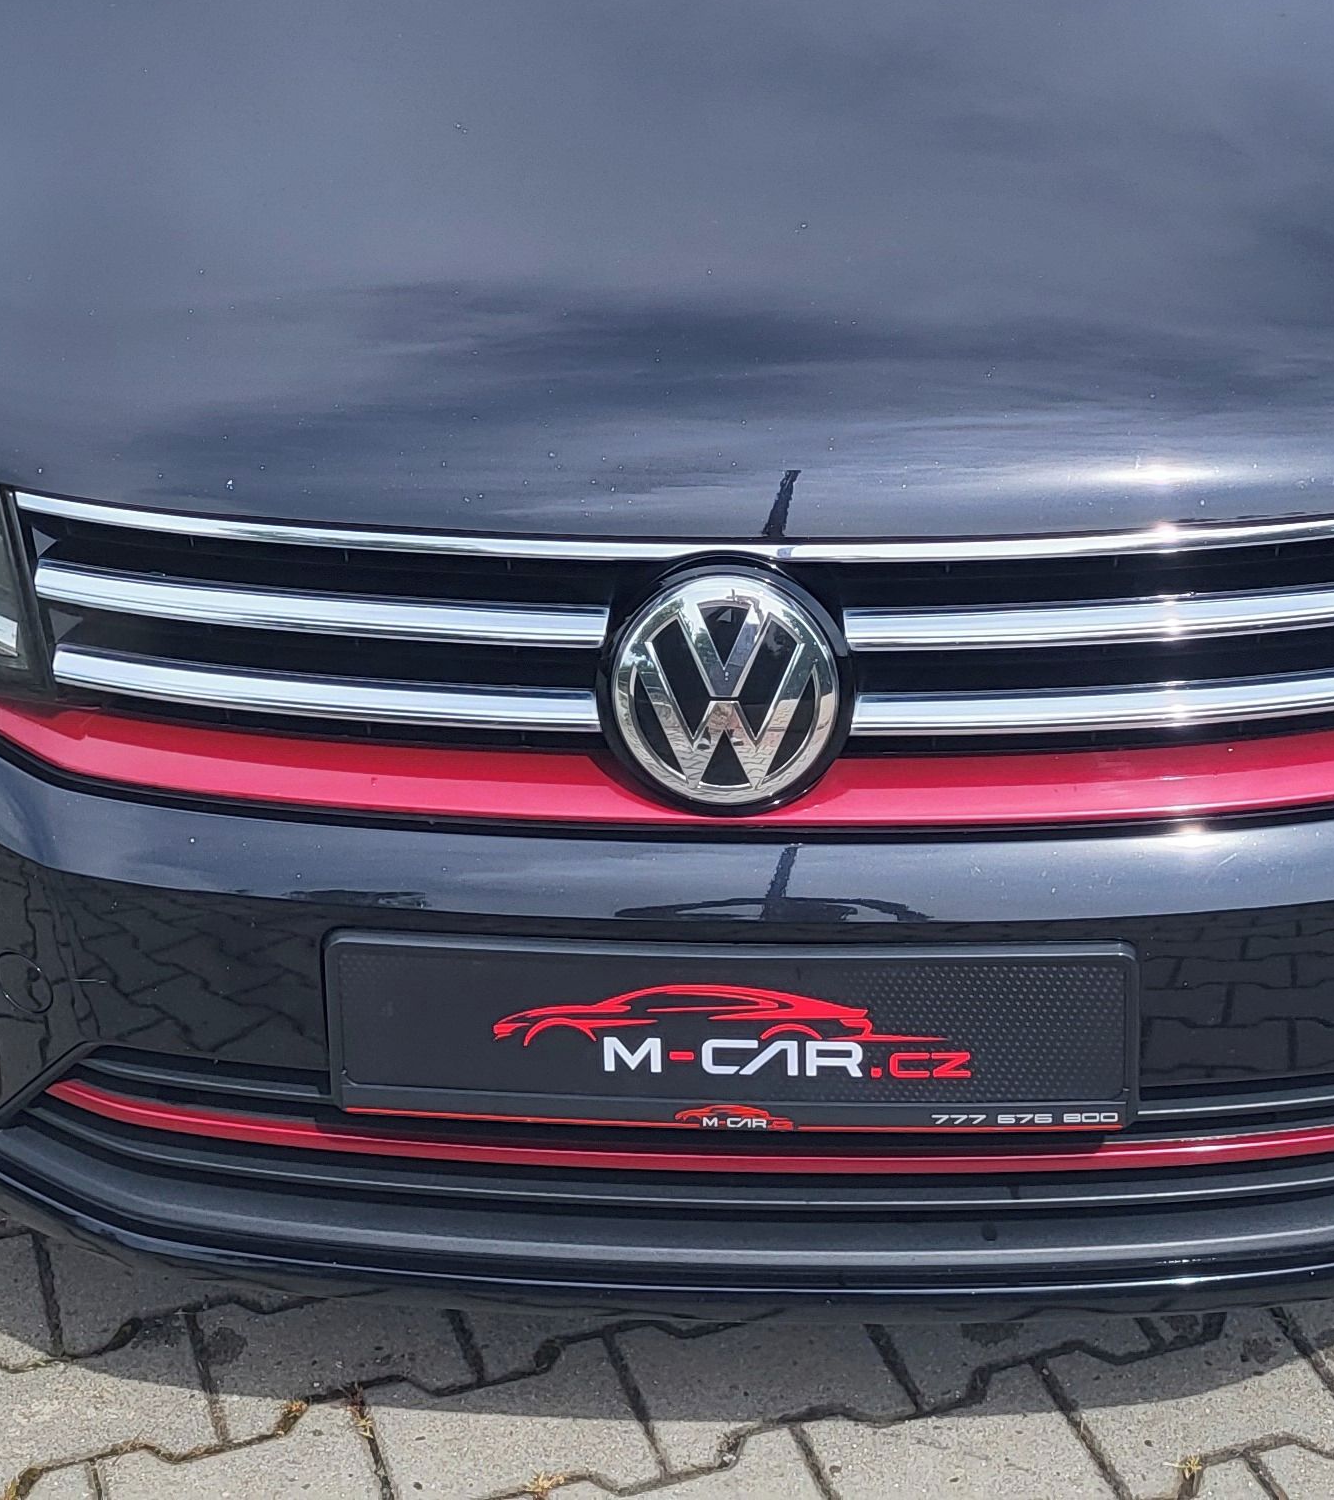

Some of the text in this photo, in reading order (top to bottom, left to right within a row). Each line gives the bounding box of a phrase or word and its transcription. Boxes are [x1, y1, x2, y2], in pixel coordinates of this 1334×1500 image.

[931, 1112, 1119, 1125] 777 676 800
